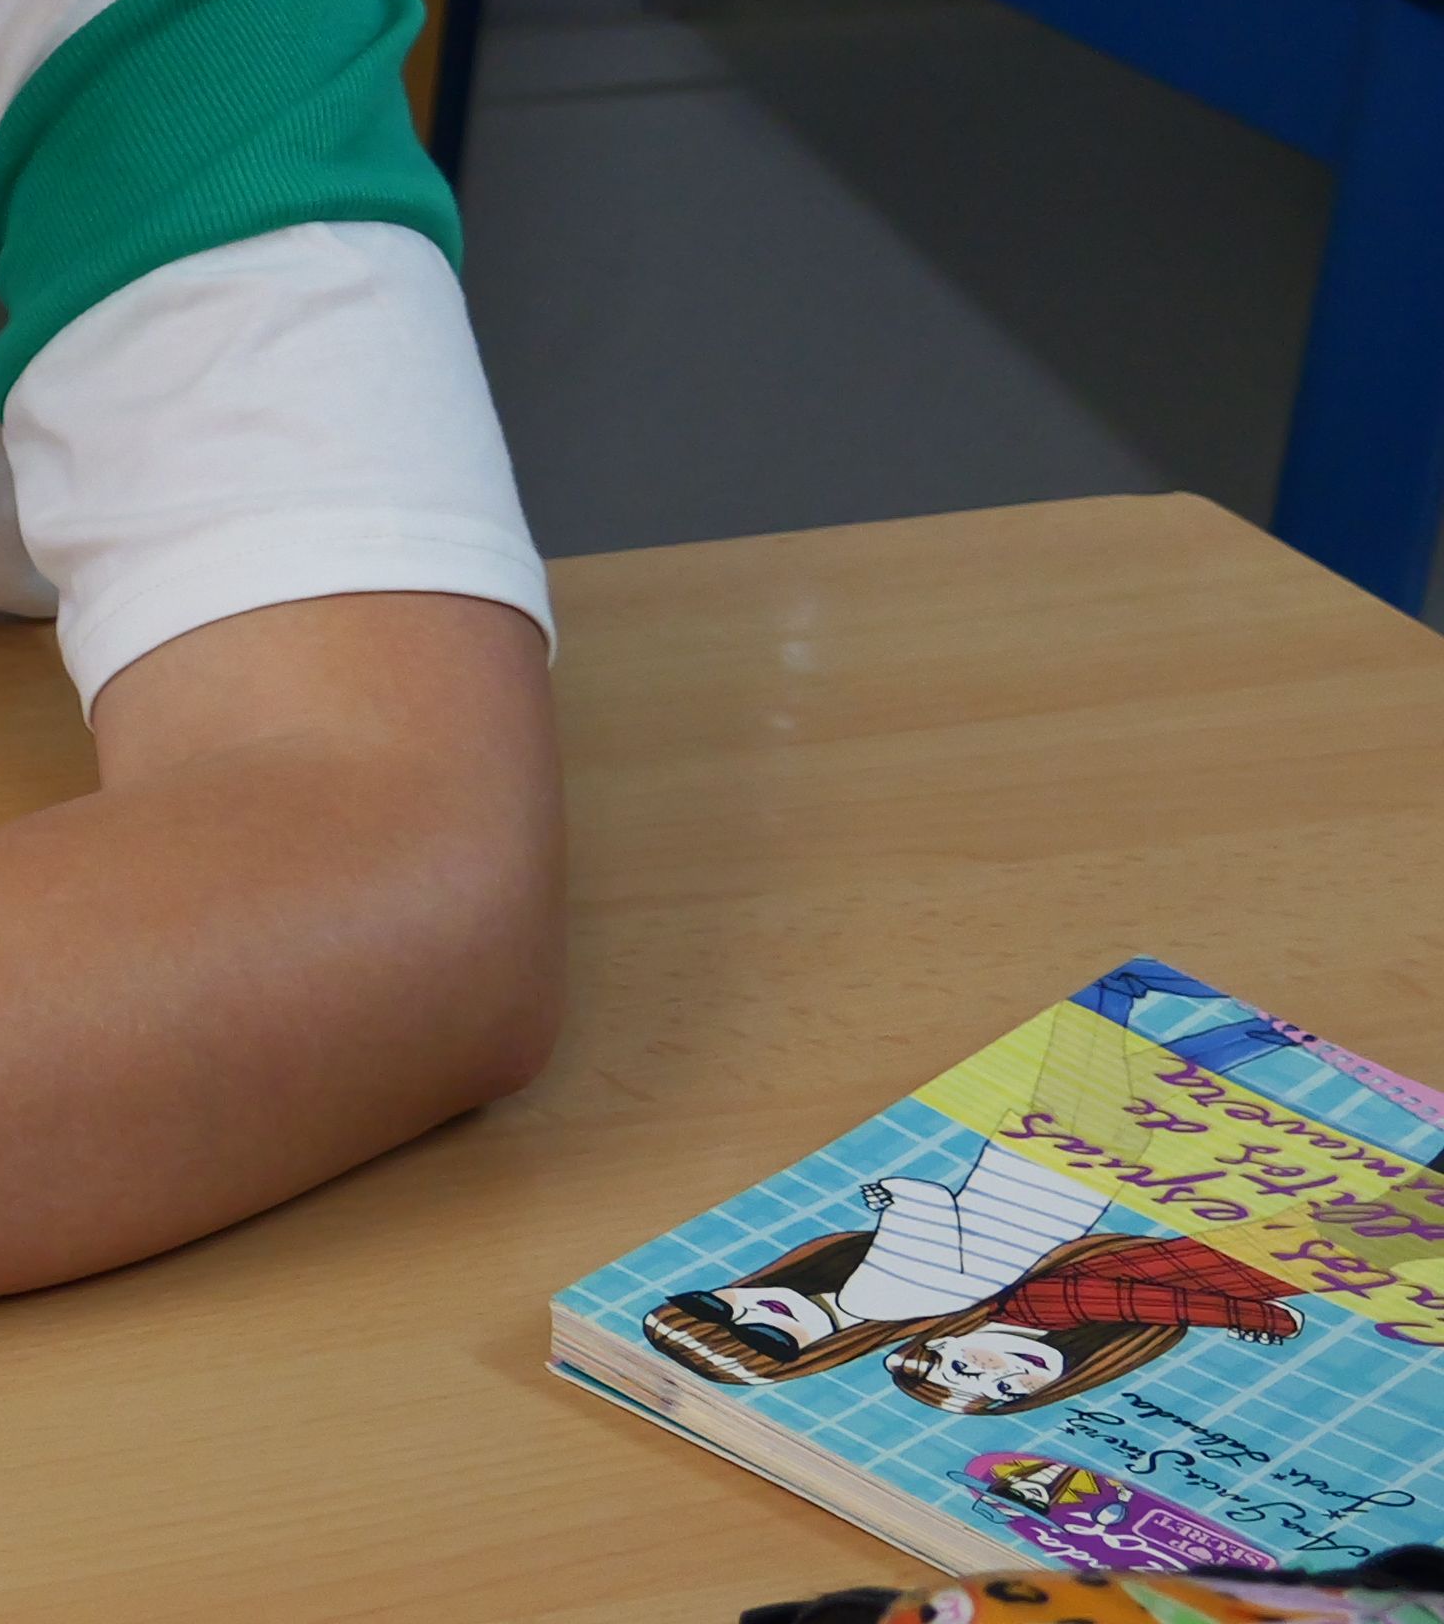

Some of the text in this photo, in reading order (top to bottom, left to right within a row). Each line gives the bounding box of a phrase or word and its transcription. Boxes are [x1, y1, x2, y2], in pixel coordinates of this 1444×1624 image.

[1121, 1097, 1209, 1137] de
[996, 1112, 1249, 1222] espías
[1121, 1392, 1270, 1467] Labanda
[1153, 1513, 1263, 1568] SECRET
